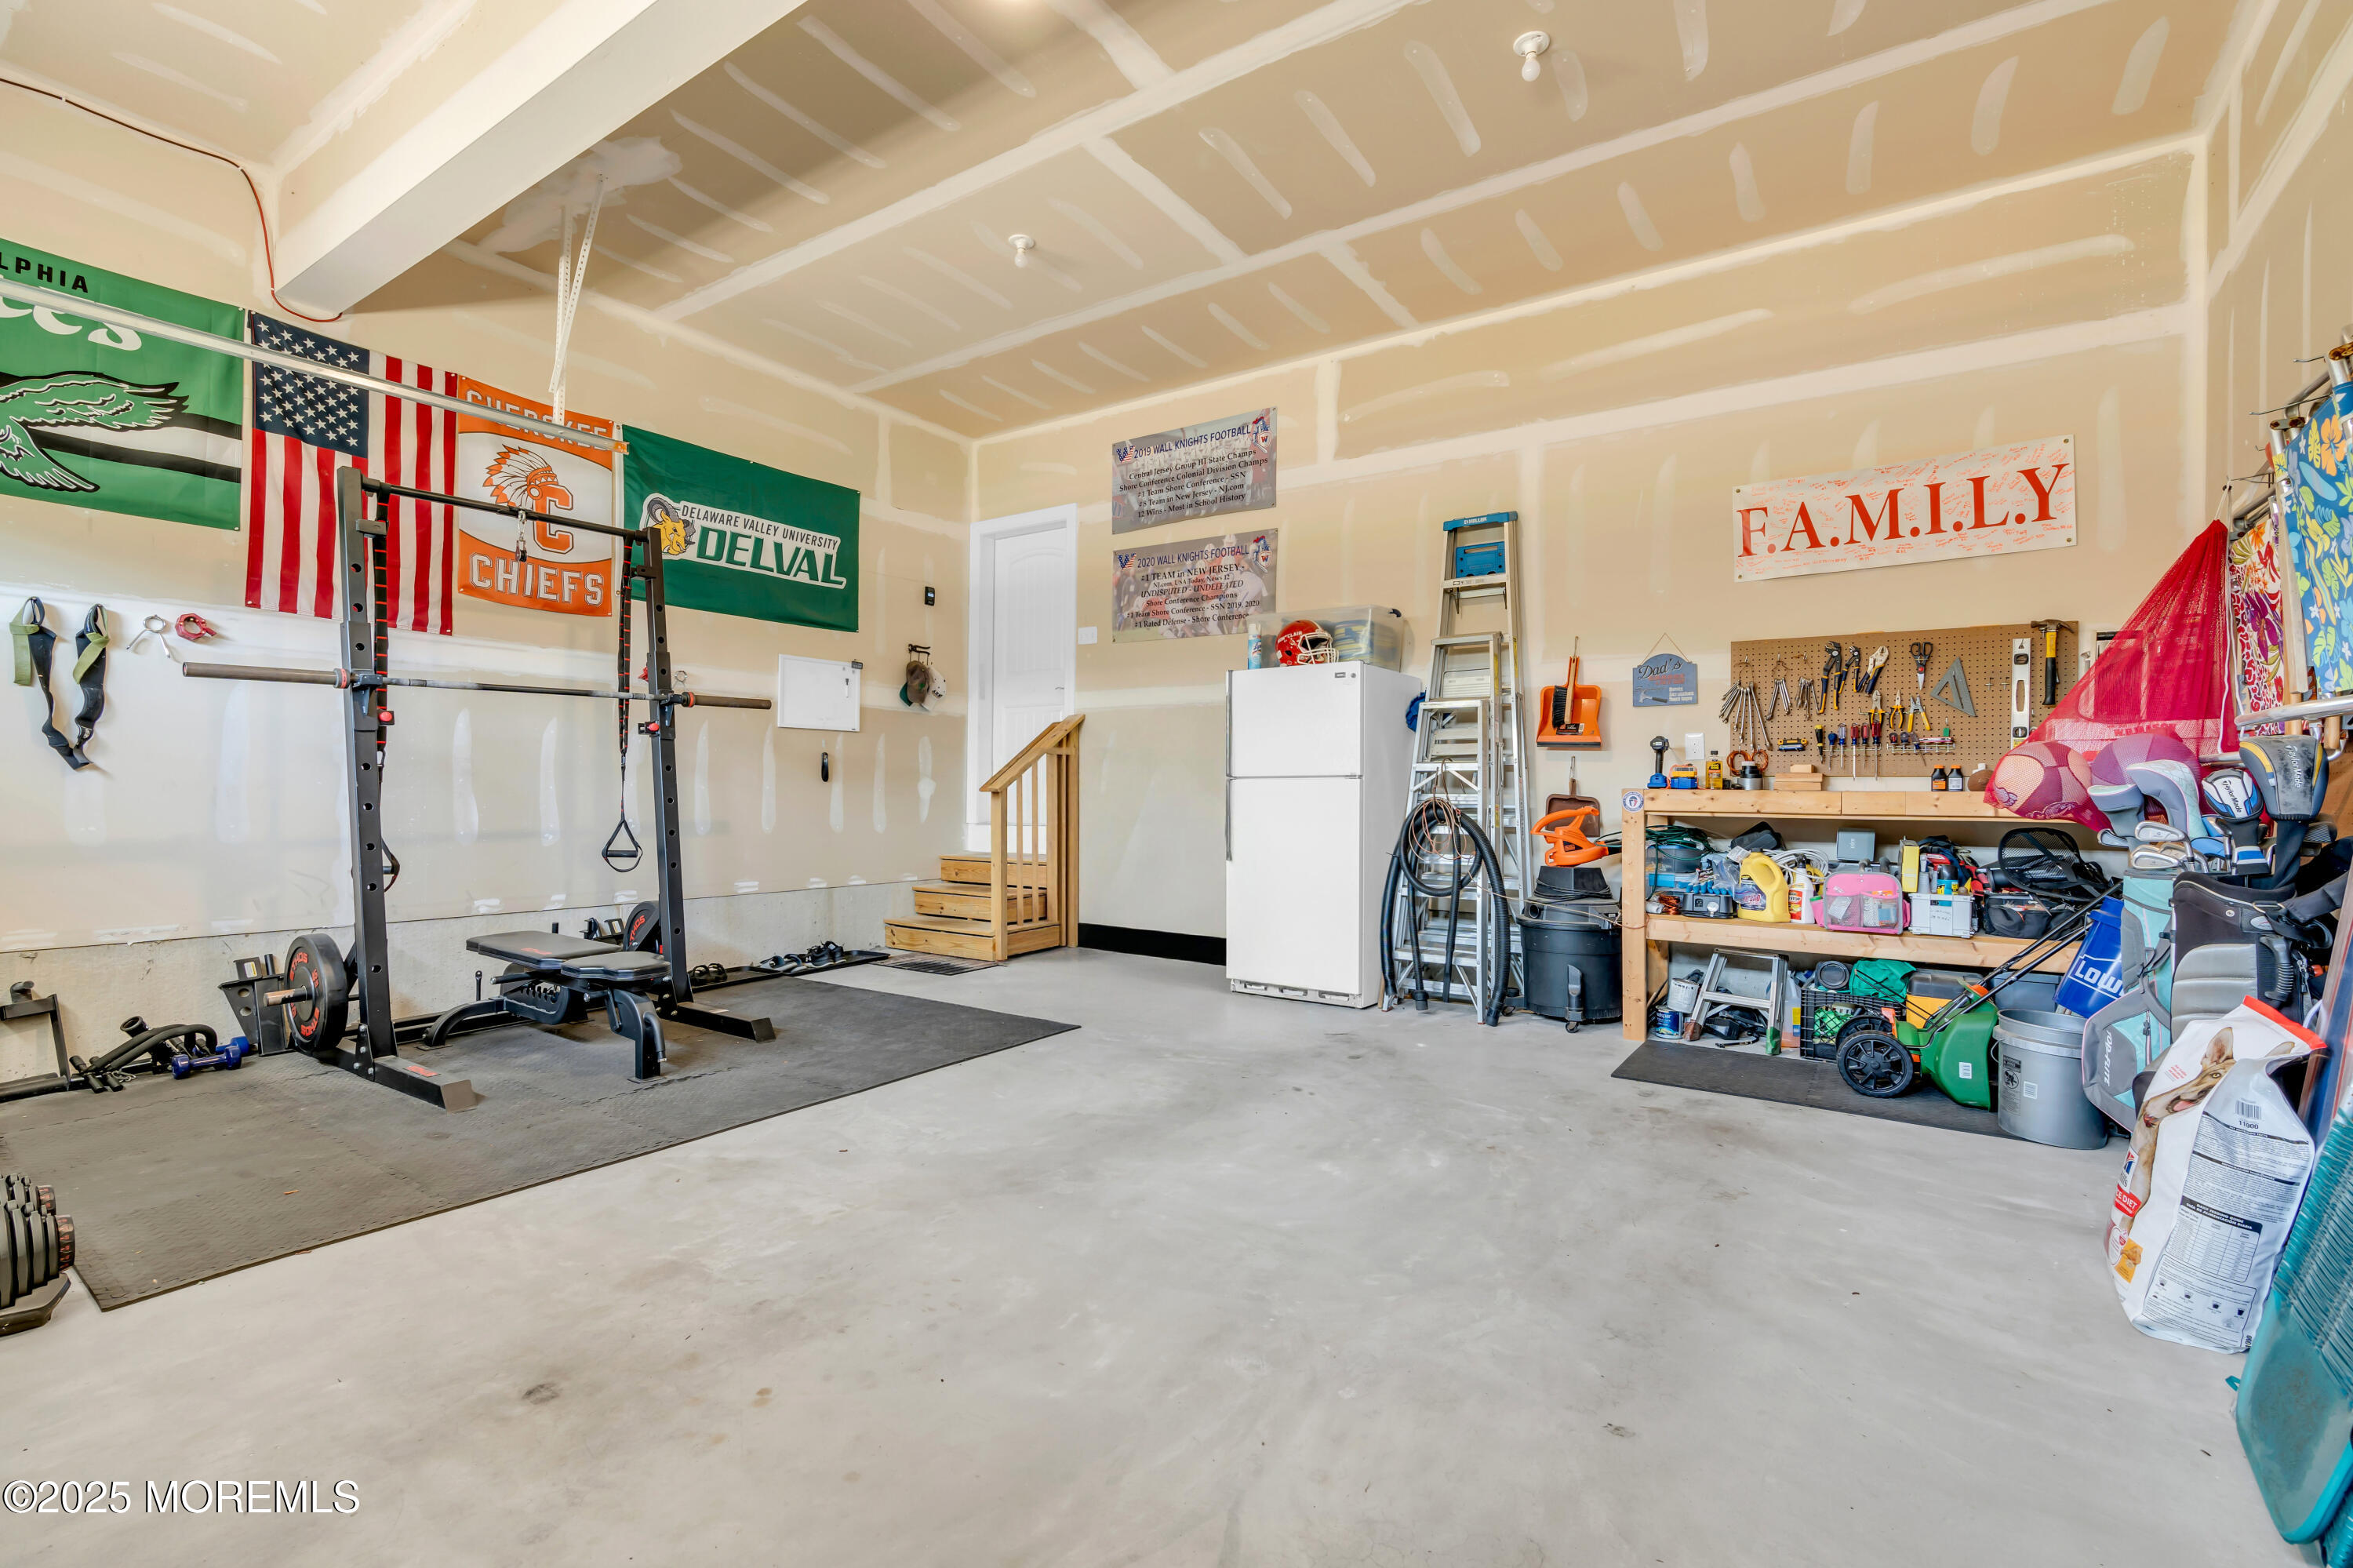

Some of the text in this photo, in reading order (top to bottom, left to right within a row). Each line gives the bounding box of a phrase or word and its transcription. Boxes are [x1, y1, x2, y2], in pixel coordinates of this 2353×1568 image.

[1134, 425, 1251, 458] 2019 WALL KNIGHTS FOOTBALL
[1119, 457, 1267, 492] Shore Conference Colonial Division Champs
[1129, 471, 1152, 480] Central
[1154, 466, 1173, 476] Jersey
[1175, 460, 1196, 471] Group
[1208, 455, 1225, 464] State
[1227, 449, 1256, 460] Champs
[1186, 477, 1224, 489] Conference
[1230, 471, 1246, 481] SSN
[1169, 504, 1185, 512] Most
[1195, 498, 1217, 508] School
[1220, 493, 1246, 504] History
[1192, 490, 1213, 501] Jersey
[1219, 484, 1244, 495] NJ.com
[1737, 463, 2070, 558] F.A.M.I.L.Y
[682, 504, 838, 551] DELAWARE VALLEY UNIVERSITY
[696, 526, 845, 586] DELVAL
[1137, 545, 1249, 568] 2020 WALL KNIGHTS FOOTBALL
[470, 551, 604, 607] CHIEFS
[1151, 571, 1175, 580] TEAM
[1187, 568, 1206, 577] NEW
[1209, 564, 1239, 575] JERSEY
[1141, 587, 1187, 598] UNDISPUTED
[1194, 580, 1243, 592] UNDEFEATED
[1165, 597, 1199, 606] Conference
[1202, 592, 1237, 602] Champions
[1171, 606, 1205, 614] Conference
[1144, 619, 1161, 628] Rated
[1638, 658, 1683, 680] Dad's
[2284, 745, 2304, 789] TaylorMade
[2221, 780, 2242, 813] TaylorMade
[630, 915, 646, 945] THOS
[2122, 1195, 2138, 1209] DIET
